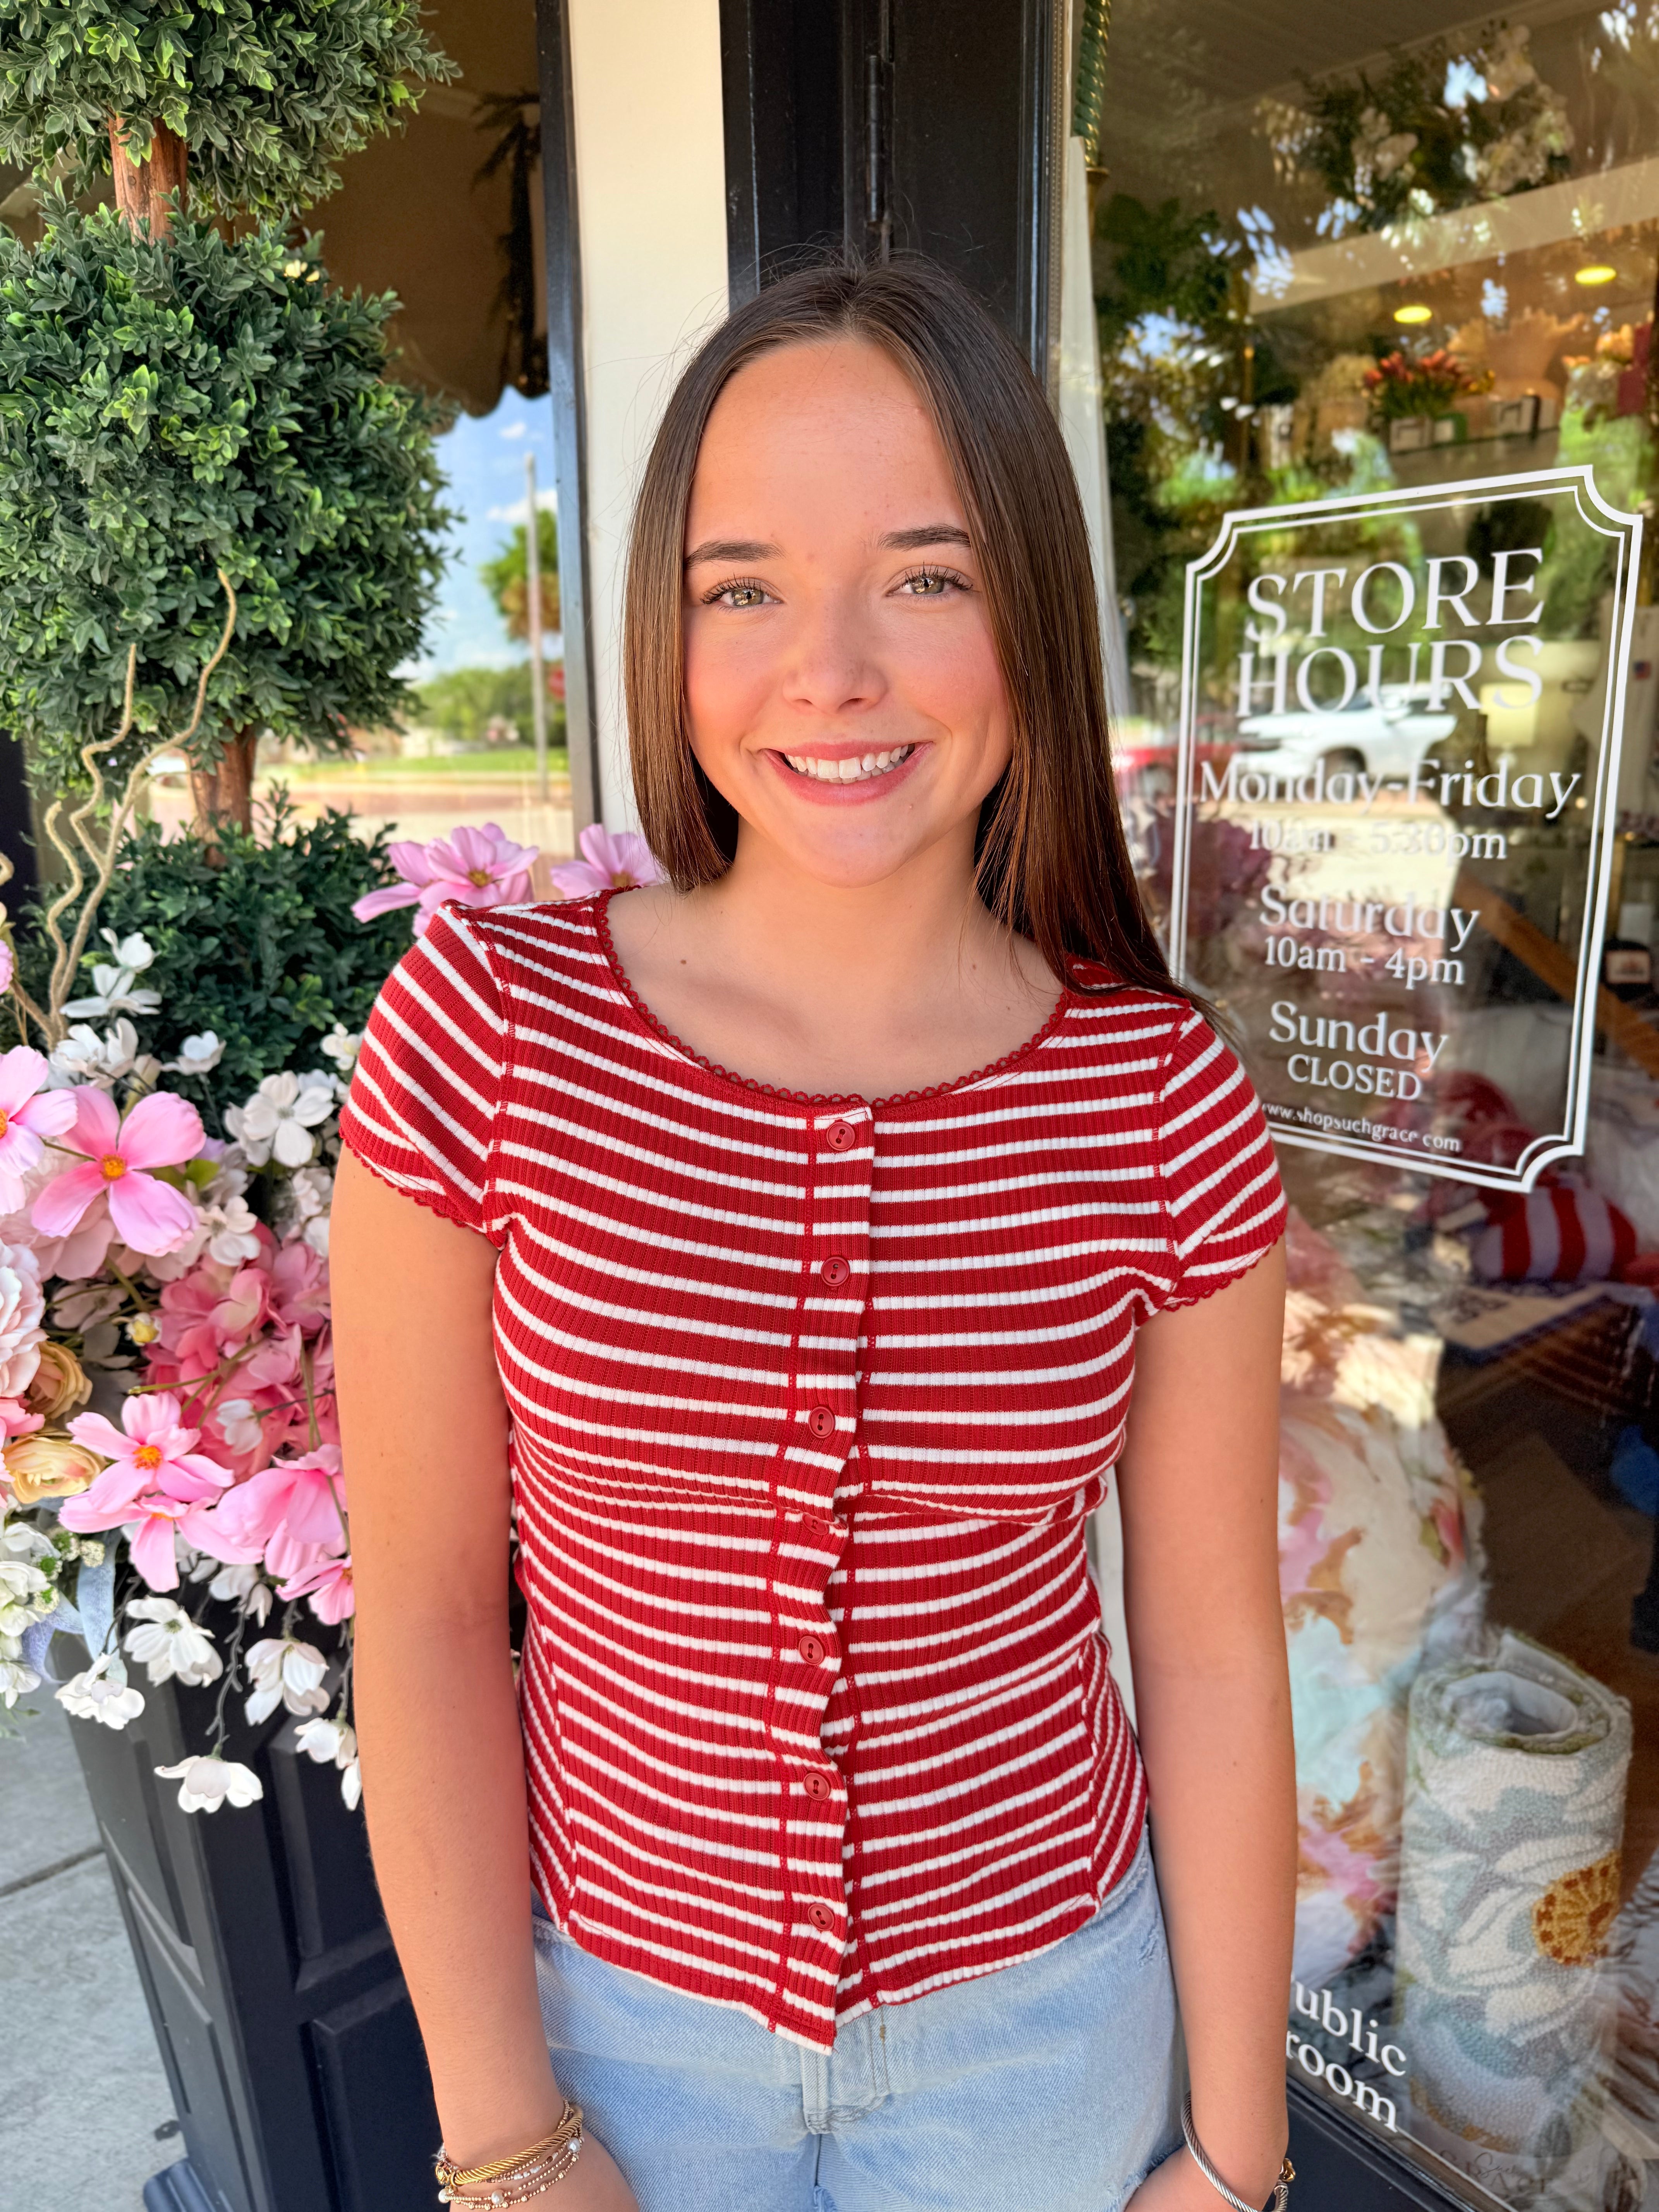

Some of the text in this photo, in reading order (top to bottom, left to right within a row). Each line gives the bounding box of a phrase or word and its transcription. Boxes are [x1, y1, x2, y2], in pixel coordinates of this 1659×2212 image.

[1245, 548, 1545, 642] STORE
[1236, 635, 1544, 717] HOURS
[1249, 820, 1331, 852] 10am
[1259, 884, 1480, 951] Saturday
[1265, 935, 1346, 972] 10am
[1384, 951, 1465, 990] 4pm
[1269, 1001, 1449, 1073] Sunday
[1288, 1054, 1422, 1101] CLOSED
[1291, 1973, 1407, 2076] ublic
